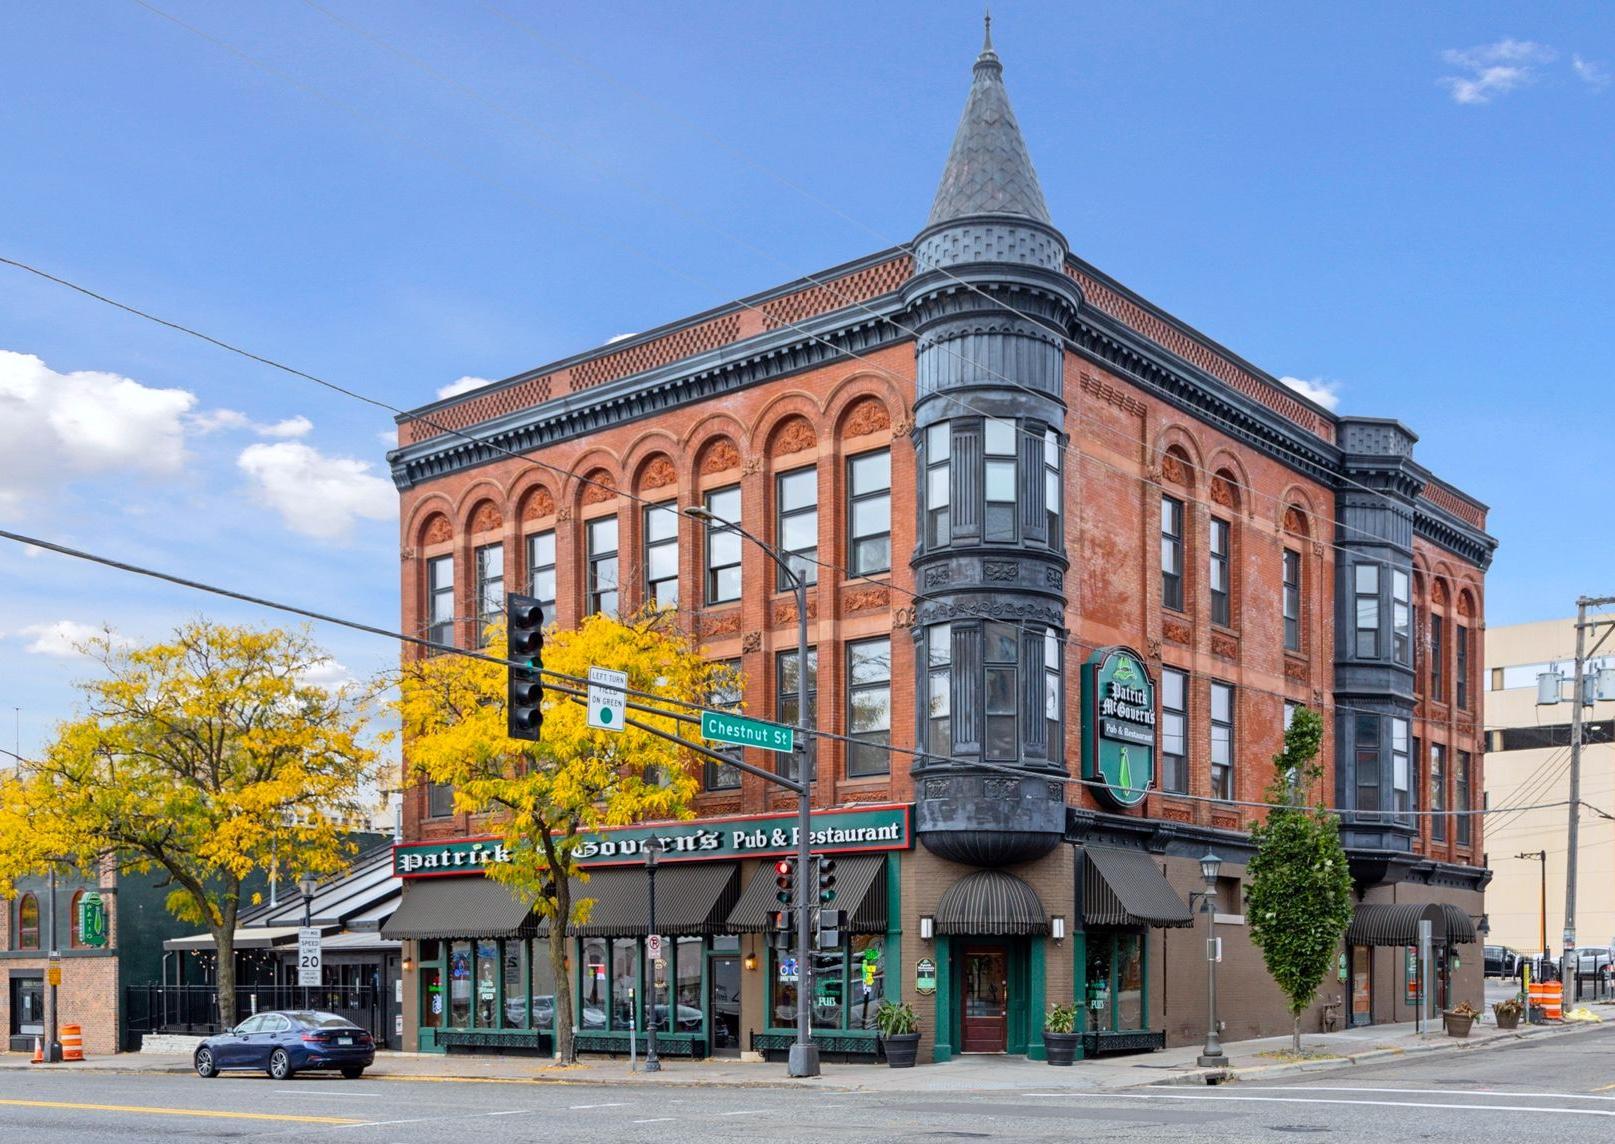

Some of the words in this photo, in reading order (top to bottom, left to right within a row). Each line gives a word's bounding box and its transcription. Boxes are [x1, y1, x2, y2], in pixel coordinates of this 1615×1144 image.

[592, 671, 607, 681] LEFT
[609, 674, 624, 683] TURN
[1112, 681, 1147, 705] Patrick
[592, 695, 600, 704] ON
[602, 697, 622, 707] GREEN
[1103, 698, 1155, 724] McGovern's
[708, 719, 768, 742] Chestnut
[774, 730, 787, 745] St
[1106, 723, 1117, 734] Pub
[1118, 726, 1123, 736] &
[398, 843, 511, 872] Patrick
[733, 829, 767, 849] Pub
[771, 827, 787, 847] &
[301, 956, 319, 968] 20
[818, 996, 836, 1007] PUB
[1091, 1000, 1104, 1009] PUB
